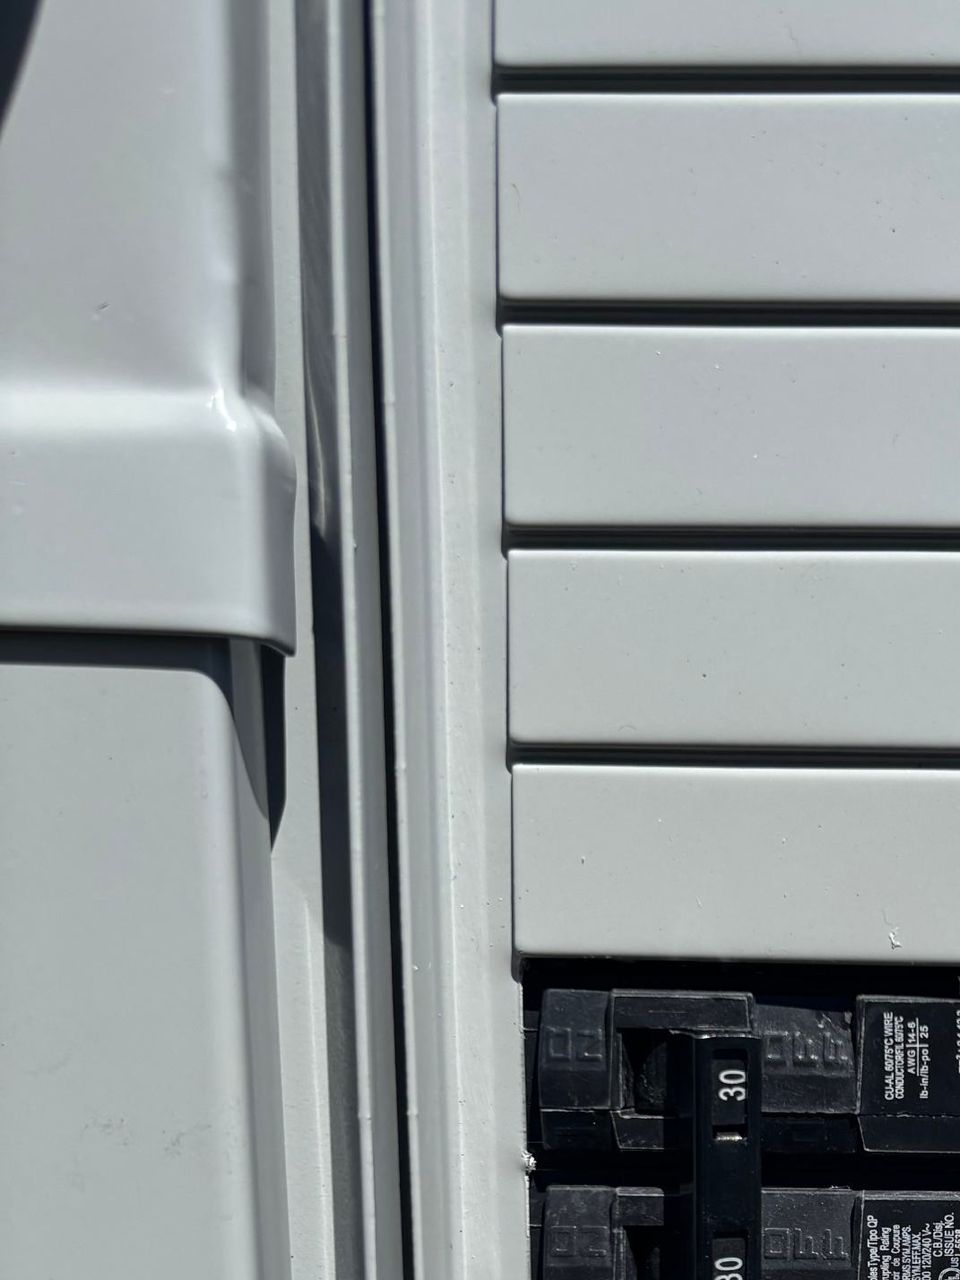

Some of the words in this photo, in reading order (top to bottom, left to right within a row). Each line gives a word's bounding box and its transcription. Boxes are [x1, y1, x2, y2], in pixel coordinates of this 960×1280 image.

[884, 1012, 892, 1036] WIRE
[921, 1026, 928, 1039] 25
[719, 1070, 746, 1101] 30
[885, 1072, 894, 1100] CU-AL
[867, 1215, 877, 1228] QP
[945, 1213, 953, 1228] NO.
[868, 1230, 879, 1267] Type/Tipo
[880, 1227, 890, 1250] Rating
[892, 1225, 901, 1254] Coupure
[945, 1231, 953, 1256] ISSUE
[892, 1258, 900, 1266] de
[922, 1238, 931, 1269] 120/240
